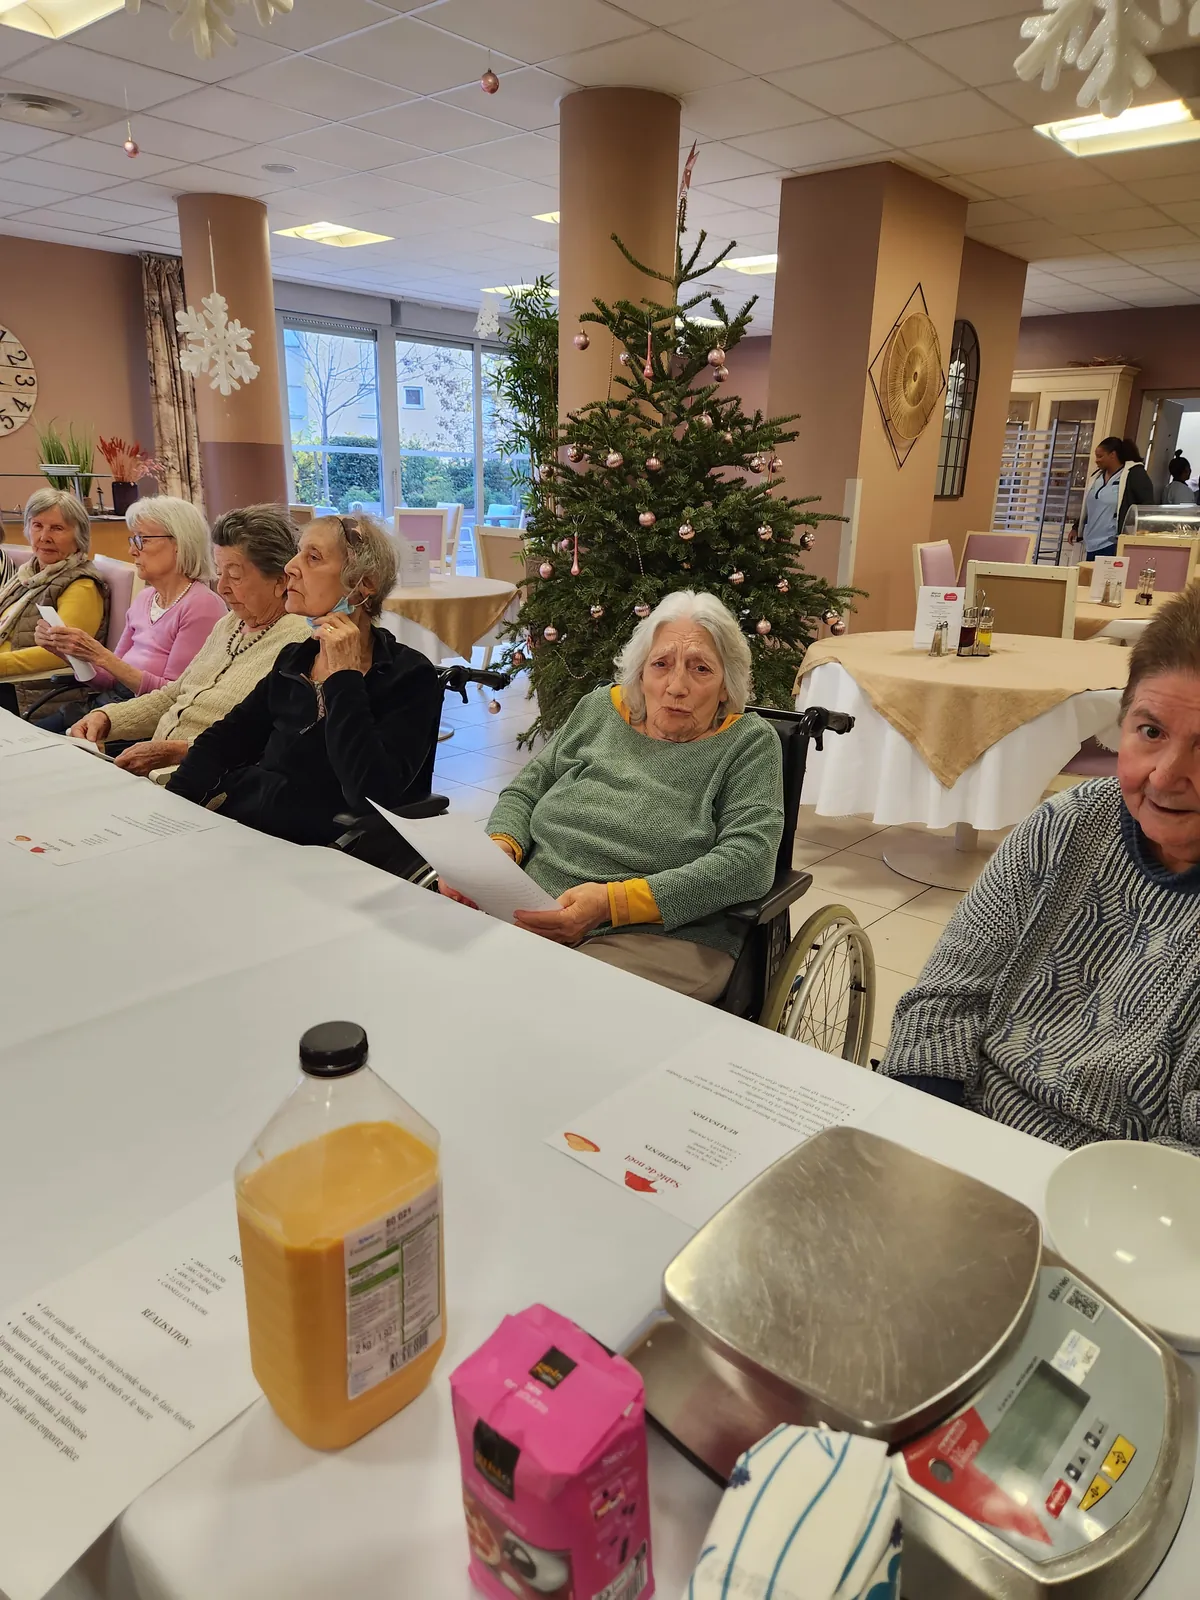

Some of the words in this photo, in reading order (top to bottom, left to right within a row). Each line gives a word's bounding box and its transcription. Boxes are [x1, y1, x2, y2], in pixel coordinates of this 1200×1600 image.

[6, 349, 28, 366] 2
[14, 374, 36, 387] 3
[11, 396, 32, 413] 4
